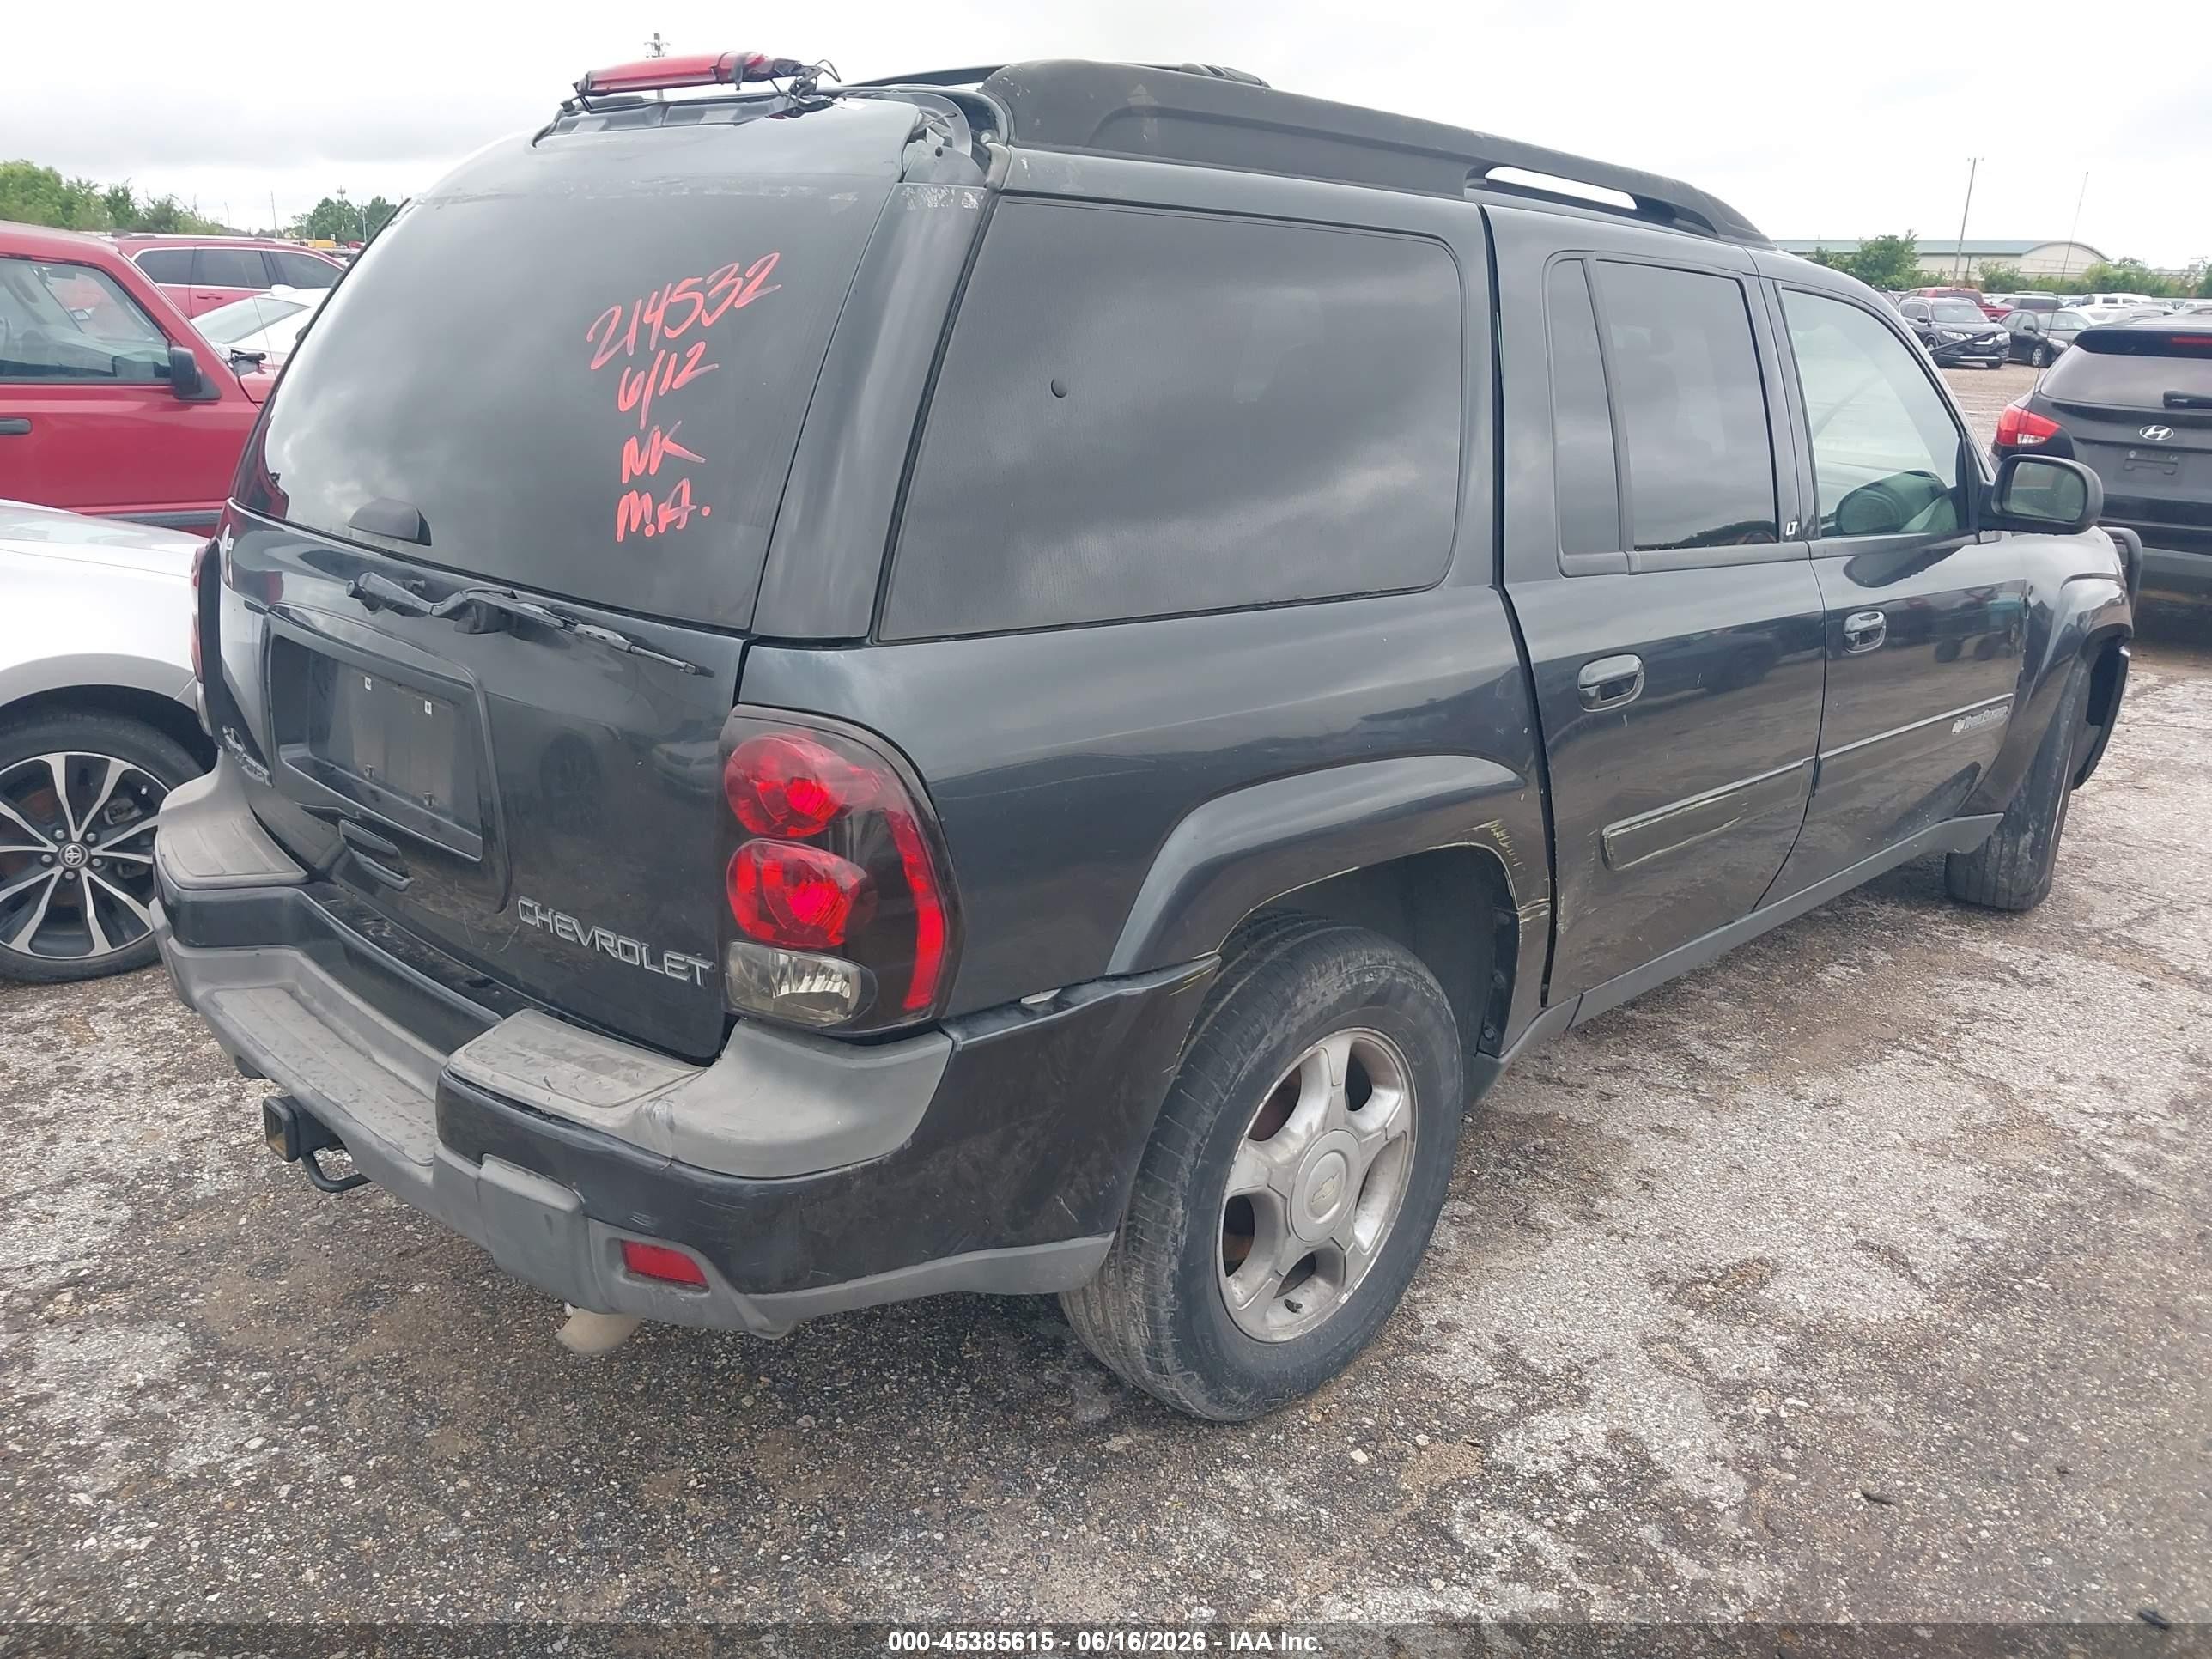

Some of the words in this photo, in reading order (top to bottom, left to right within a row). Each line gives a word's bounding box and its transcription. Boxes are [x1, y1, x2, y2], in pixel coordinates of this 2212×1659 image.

[586, 252, 782, 370] 214532
[617, 341, 720, 430] 6/12
[621, 420, 707, 484] NK
[1785, 520, 1798, 536] LT
[517, 896, 715, 987] CHEVROLET
